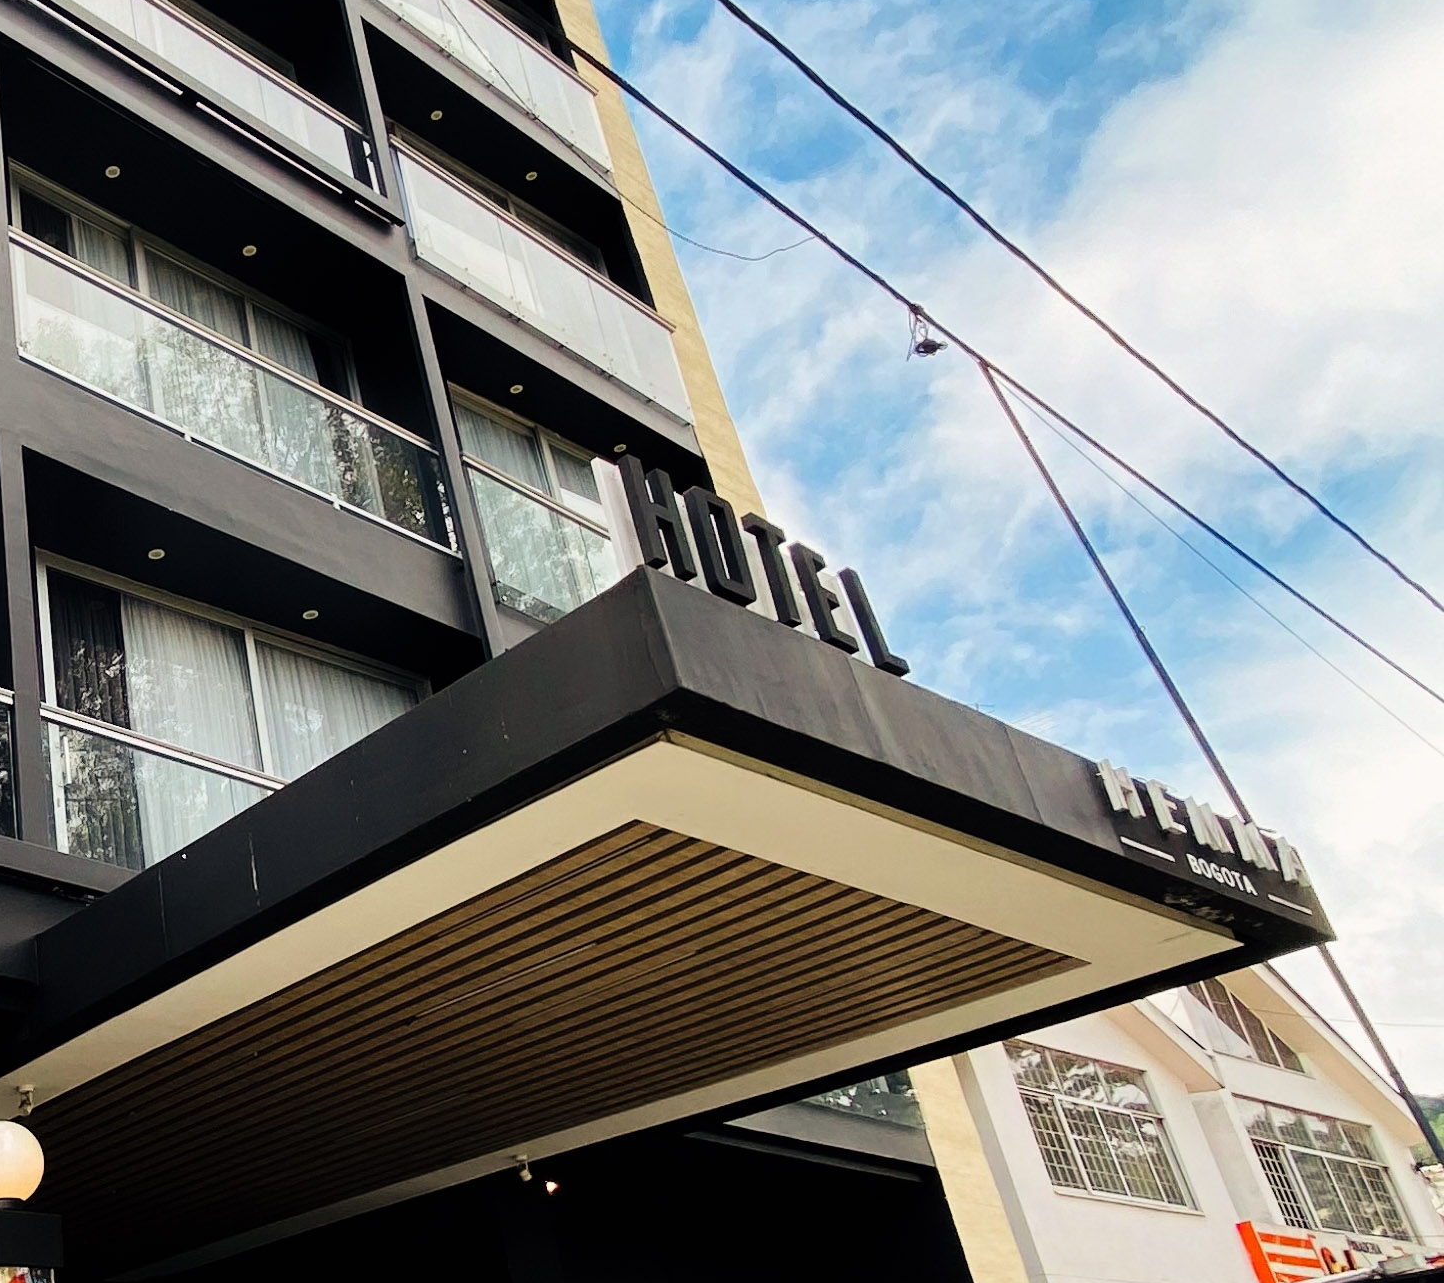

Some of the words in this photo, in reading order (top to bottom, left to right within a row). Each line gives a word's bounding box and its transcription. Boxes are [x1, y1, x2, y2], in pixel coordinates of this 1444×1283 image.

[615, 453, 910, 677] HOTEL
[1097, 759, 1312, 888] HEMMA
[1185, 853, 1258, 897] BOGOTA
